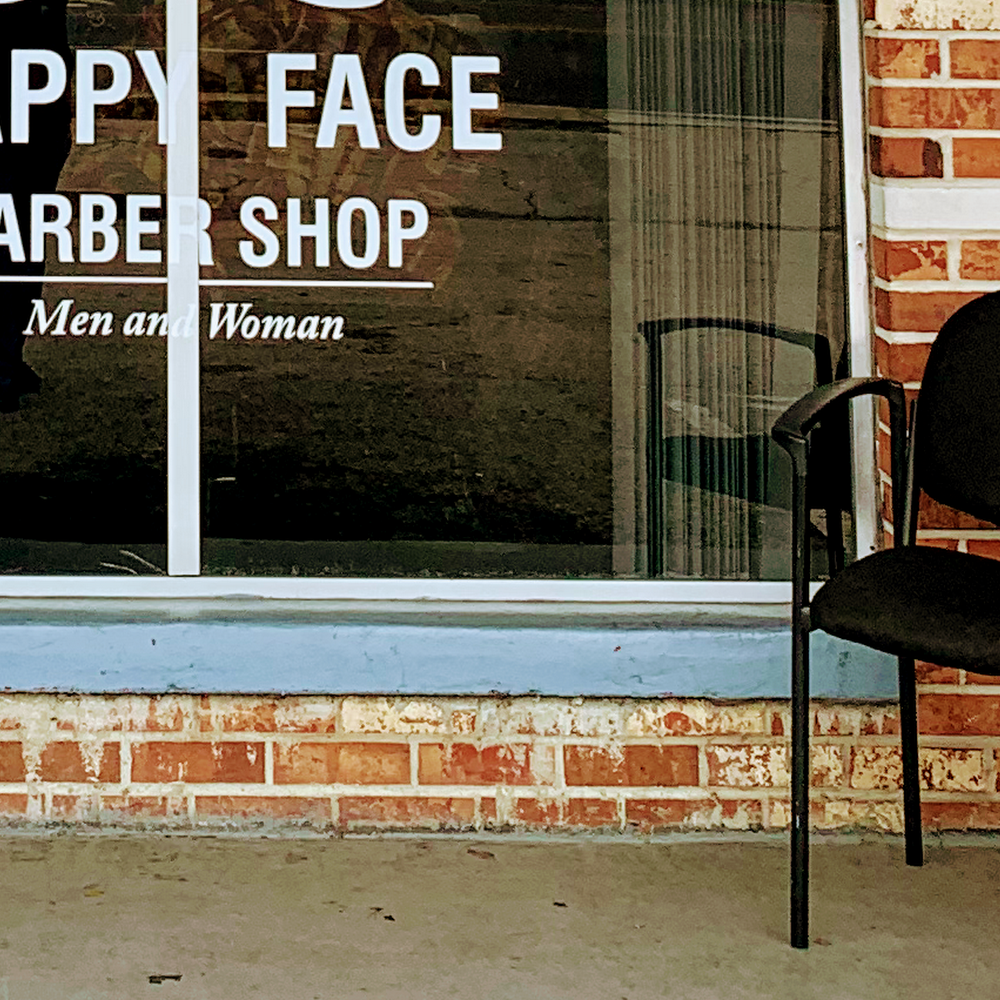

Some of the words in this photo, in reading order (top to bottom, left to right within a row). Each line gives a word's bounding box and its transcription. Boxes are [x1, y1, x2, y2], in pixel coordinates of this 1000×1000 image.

[265, 53, 503, 152] FACE
[238, 197, 430, 268] SHOP
[23, 299, 114, 337] Men
[209, 303, 345, 340] Woman
